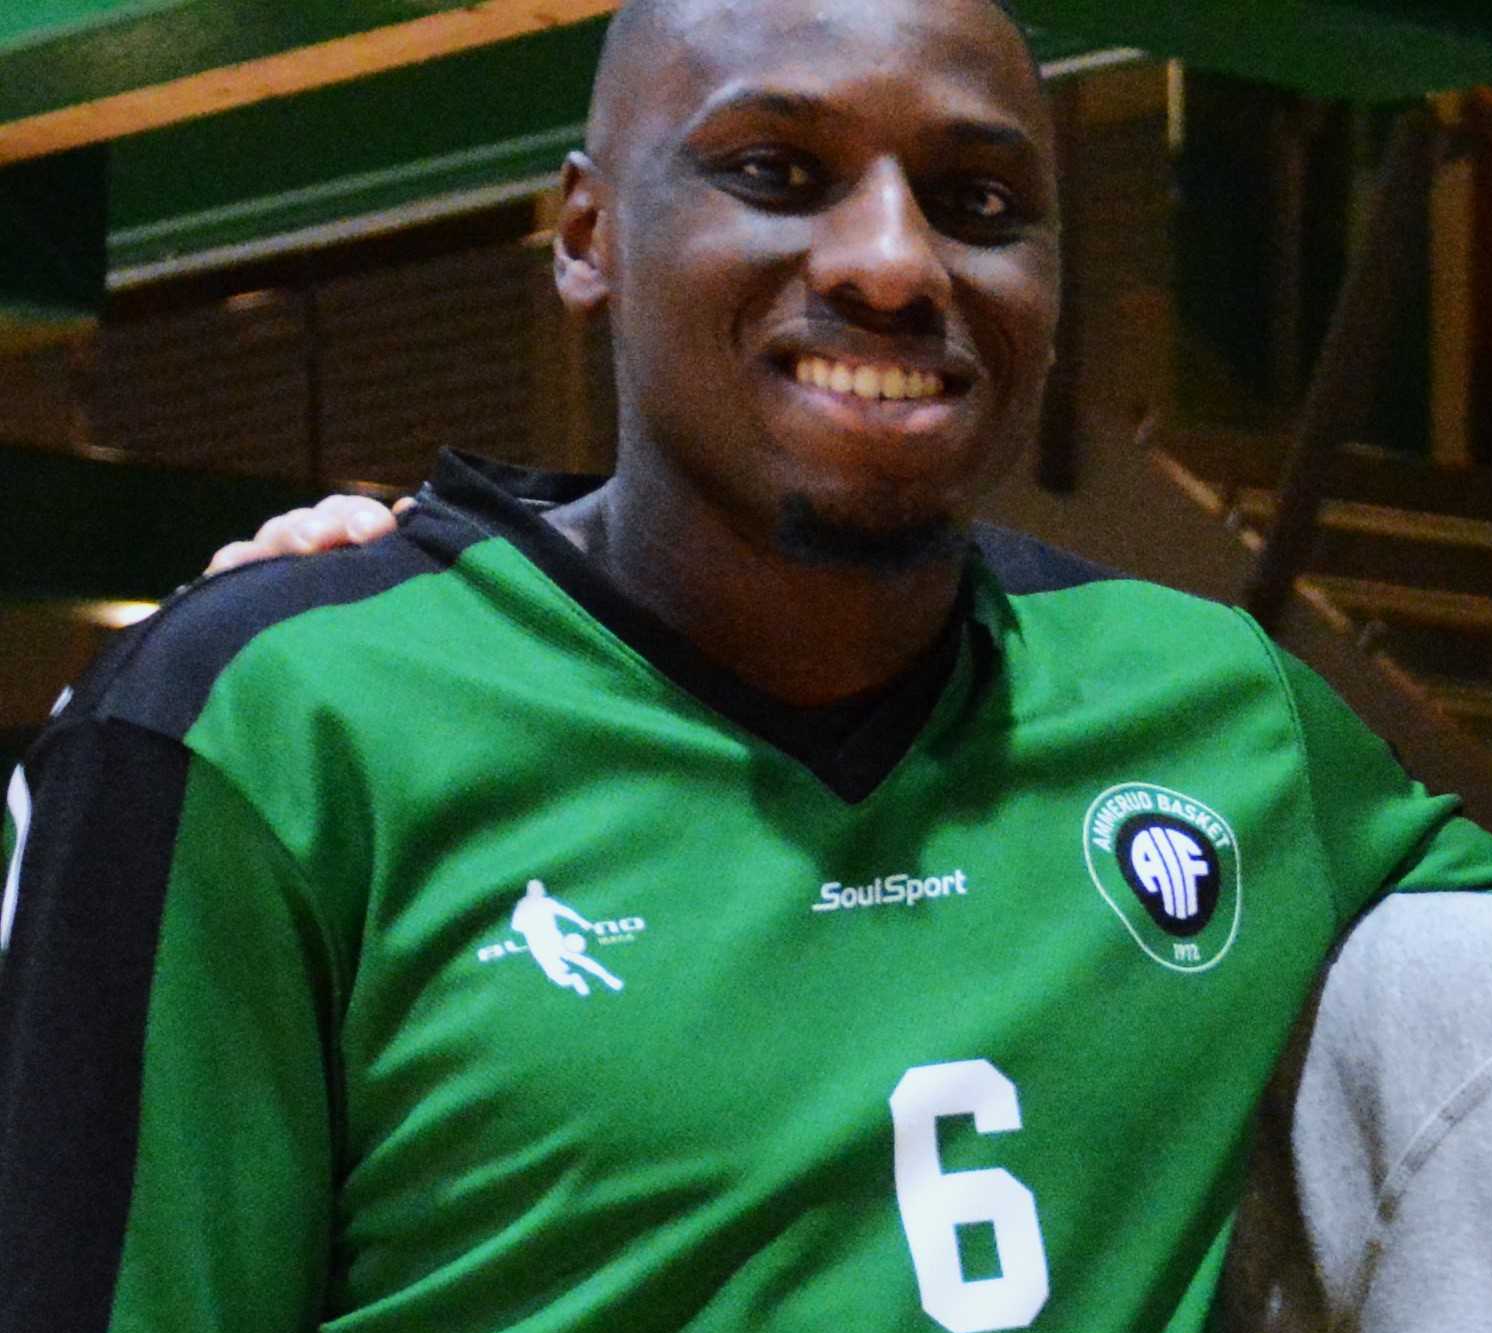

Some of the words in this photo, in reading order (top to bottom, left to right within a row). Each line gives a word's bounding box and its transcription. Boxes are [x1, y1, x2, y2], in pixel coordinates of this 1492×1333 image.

[1092, 791, 1153, 853] AMMERUD
[1156, 794, 1230, 848] BASKET
[811, 869, 967, 911] SoulSport
[1131, 827, 1209, 920] AIF
